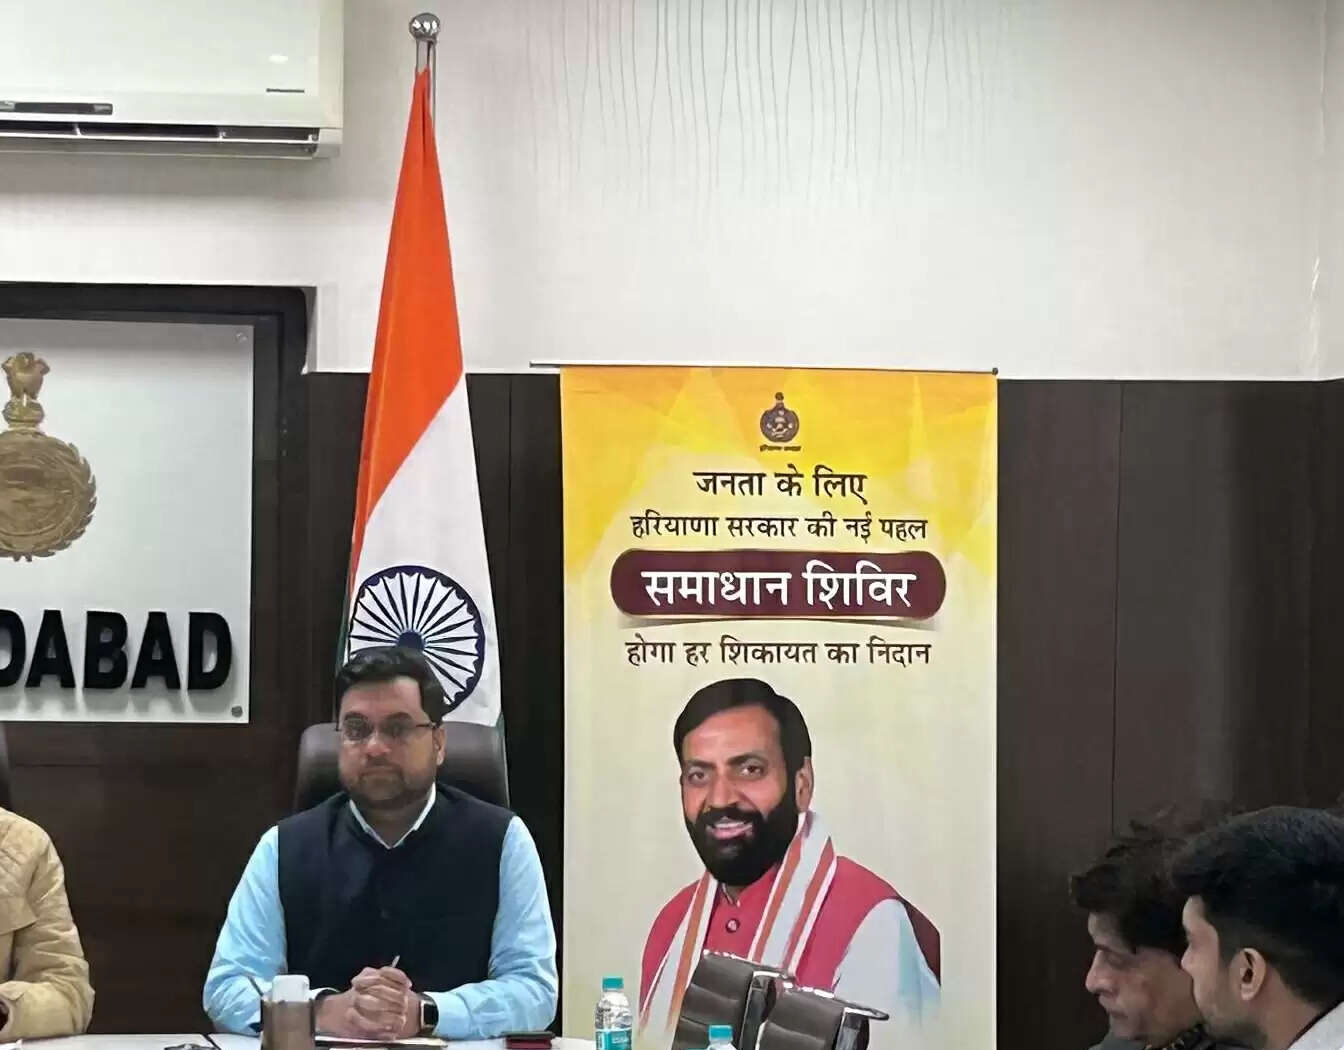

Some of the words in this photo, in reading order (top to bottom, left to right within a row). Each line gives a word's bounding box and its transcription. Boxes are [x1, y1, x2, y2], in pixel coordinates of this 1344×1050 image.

[692, 471, 767, 496] जनता
[774, 463, 804, 497] के
[812, 464, 868, 506] लिए
[629, 508, 720, 539] हरियाणा
[725, 517, 800, 537] सरकार
[804, 510, 838, 537] की
[842, 510, 873, 544] नई
[878, 518, 929, 542] पहल
[640, 570, 793, 607] समाधान
[801, 559, 918, 611] शिविर
[624, 633, 677, 667] होगा
[682, 642, 712, 667] हर
[719, 634, 818, 665] शिकायत
[823, 643, 860, 664] का
[866, 635, 932, 668] निदान
